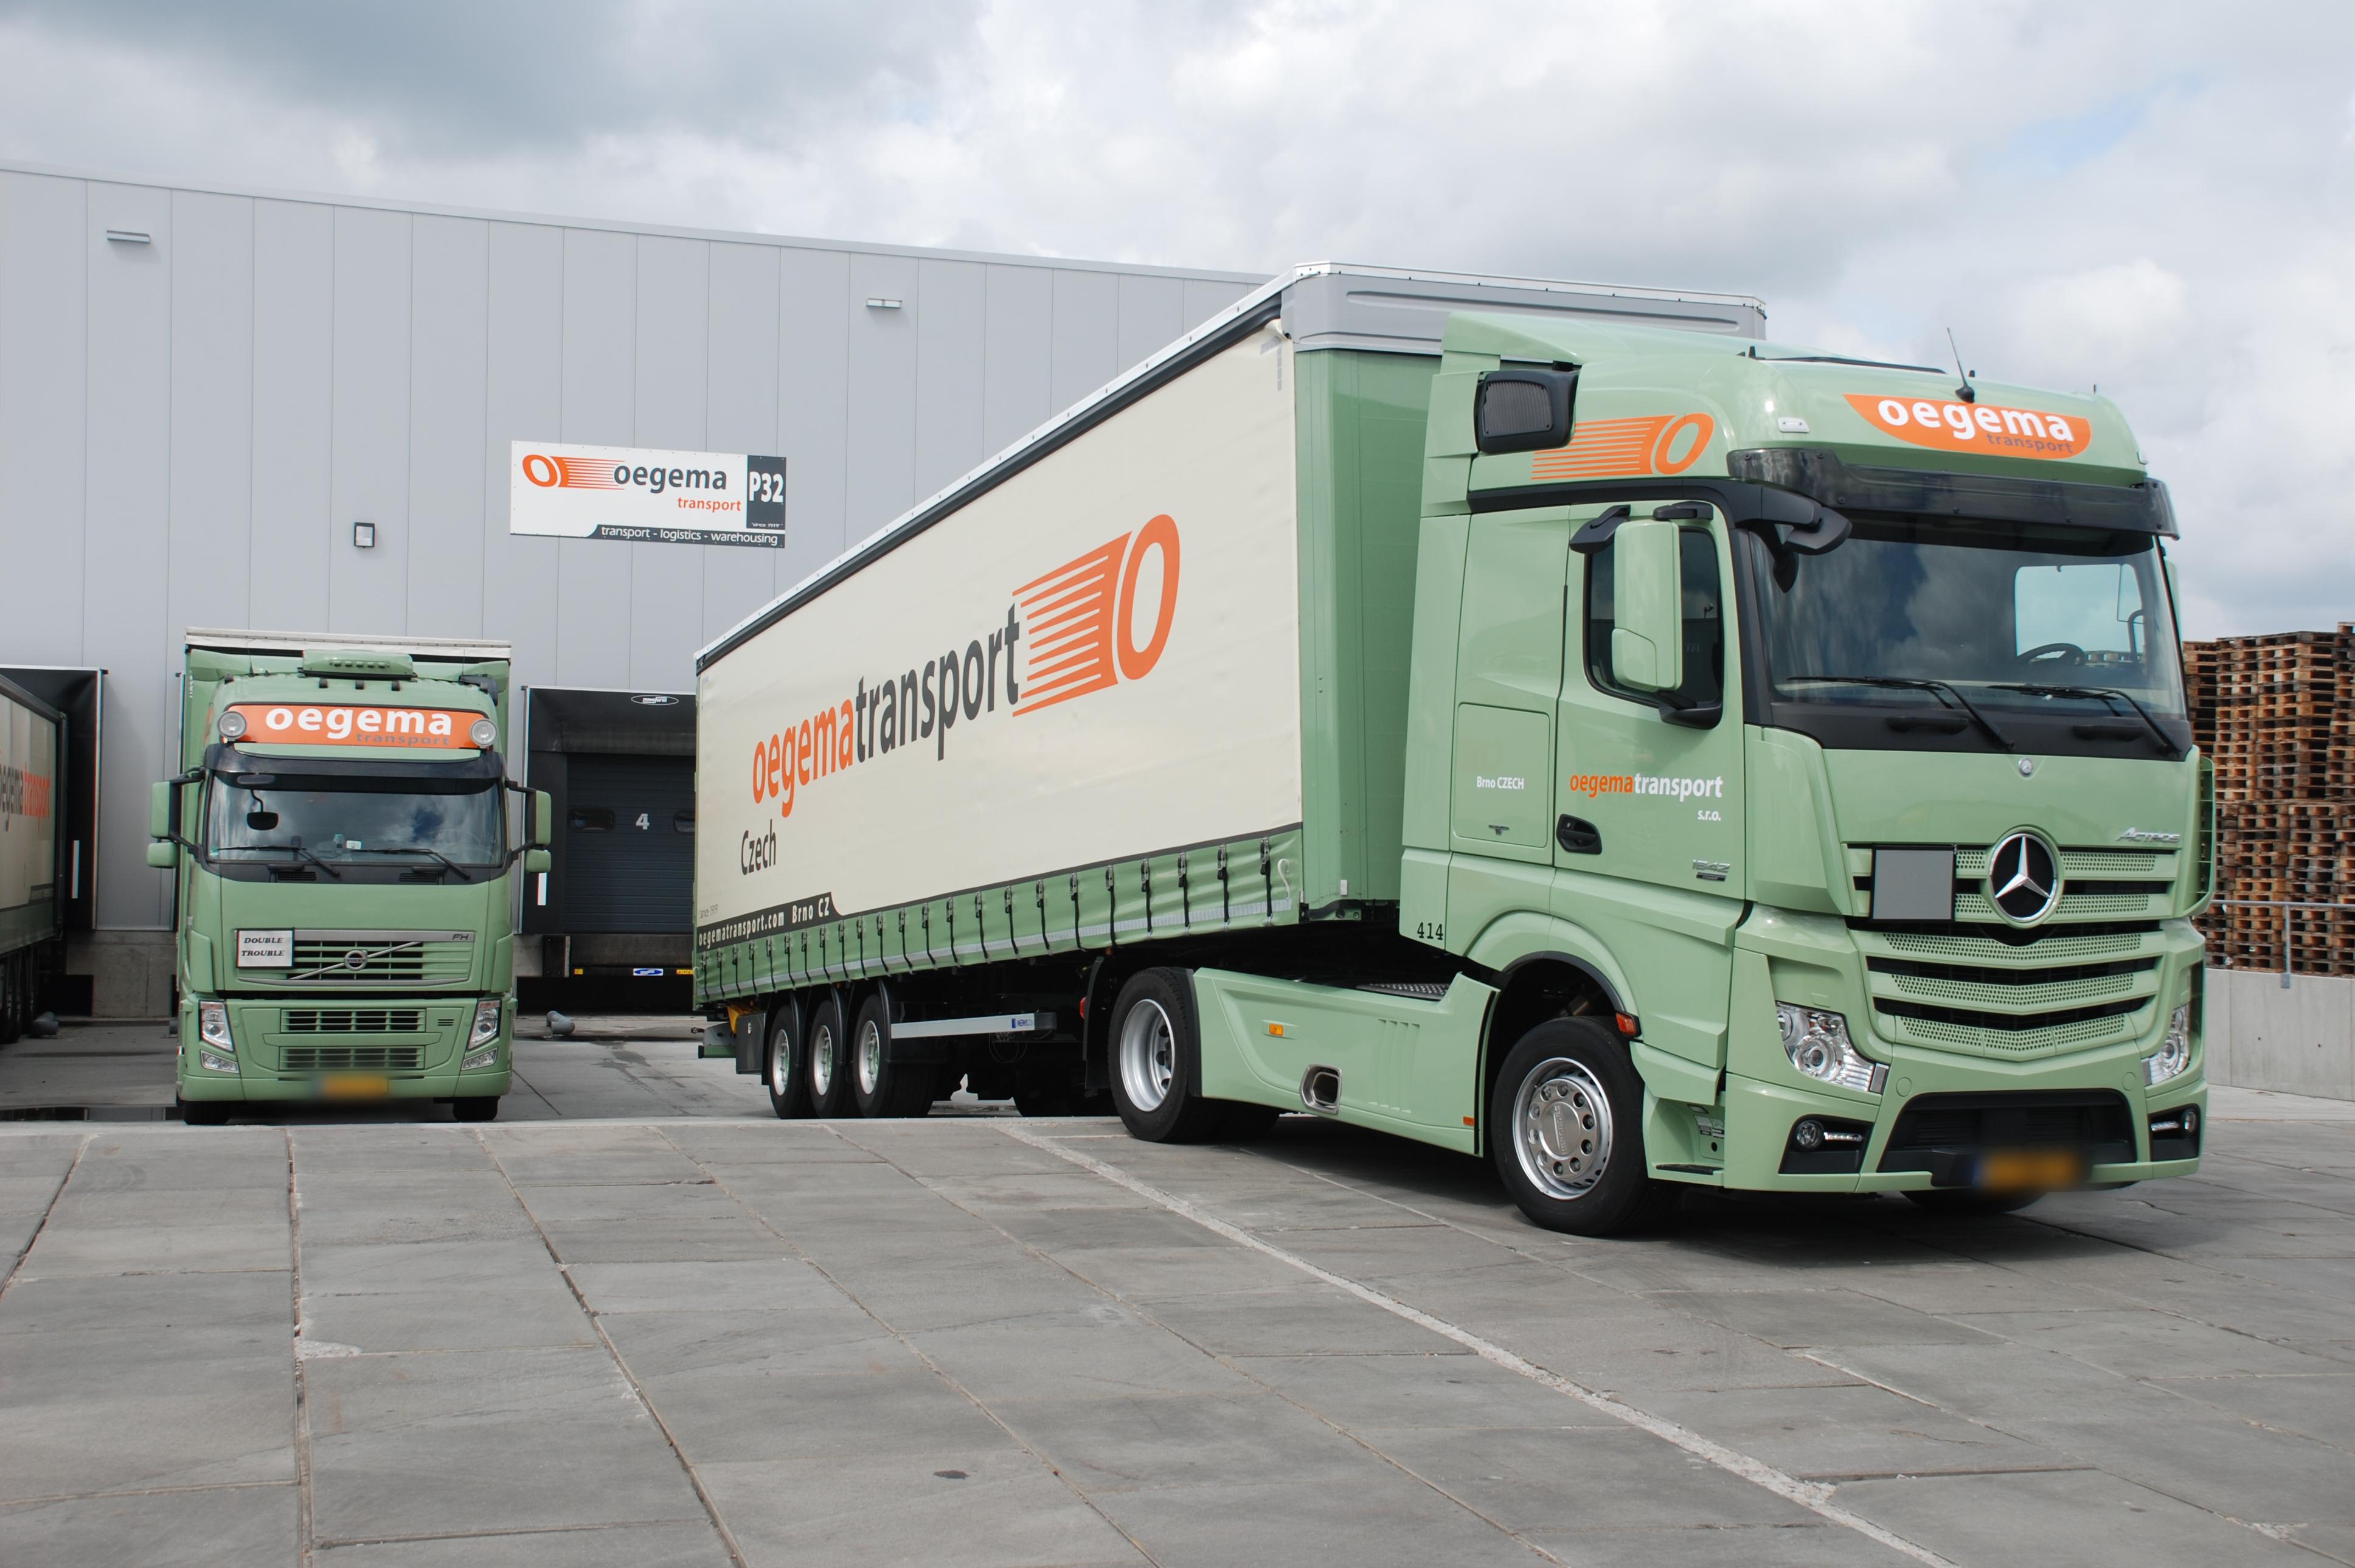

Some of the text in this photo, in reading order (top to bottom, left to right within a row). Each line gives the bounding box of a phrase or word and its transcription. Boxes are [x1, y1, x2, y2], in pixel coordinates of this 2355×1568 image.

[1878, 399, 2075, 442] oegema
[1986, 432, 2073, 454] transport
[614, 465, 727, 494] oegema
[749, 471, 784, 503] P32
[677, 496, 741, 513] transport
[601, 526, 650, 539] transport
[660, 529, 701, 541] logistics
[710, 532, 778, 546] warehousing
[752, 602, 1020, 818] oegematransport
[266, 707, 452, 740] oegema
[355, 732, 451, 747] transport
[1476, 775, 1525, 790] Brno CZECH
[1570, 772, 1723, 802] oegematransport
[636, 813, 650, 830] 4
[1697, 809, 1722, 821] s.r.o.
[741, 819, 777, 876] Czech
[698, 896, 830, 949] oegematransport.com Brno CZ
[1417, 921, 1445, 941] 414
